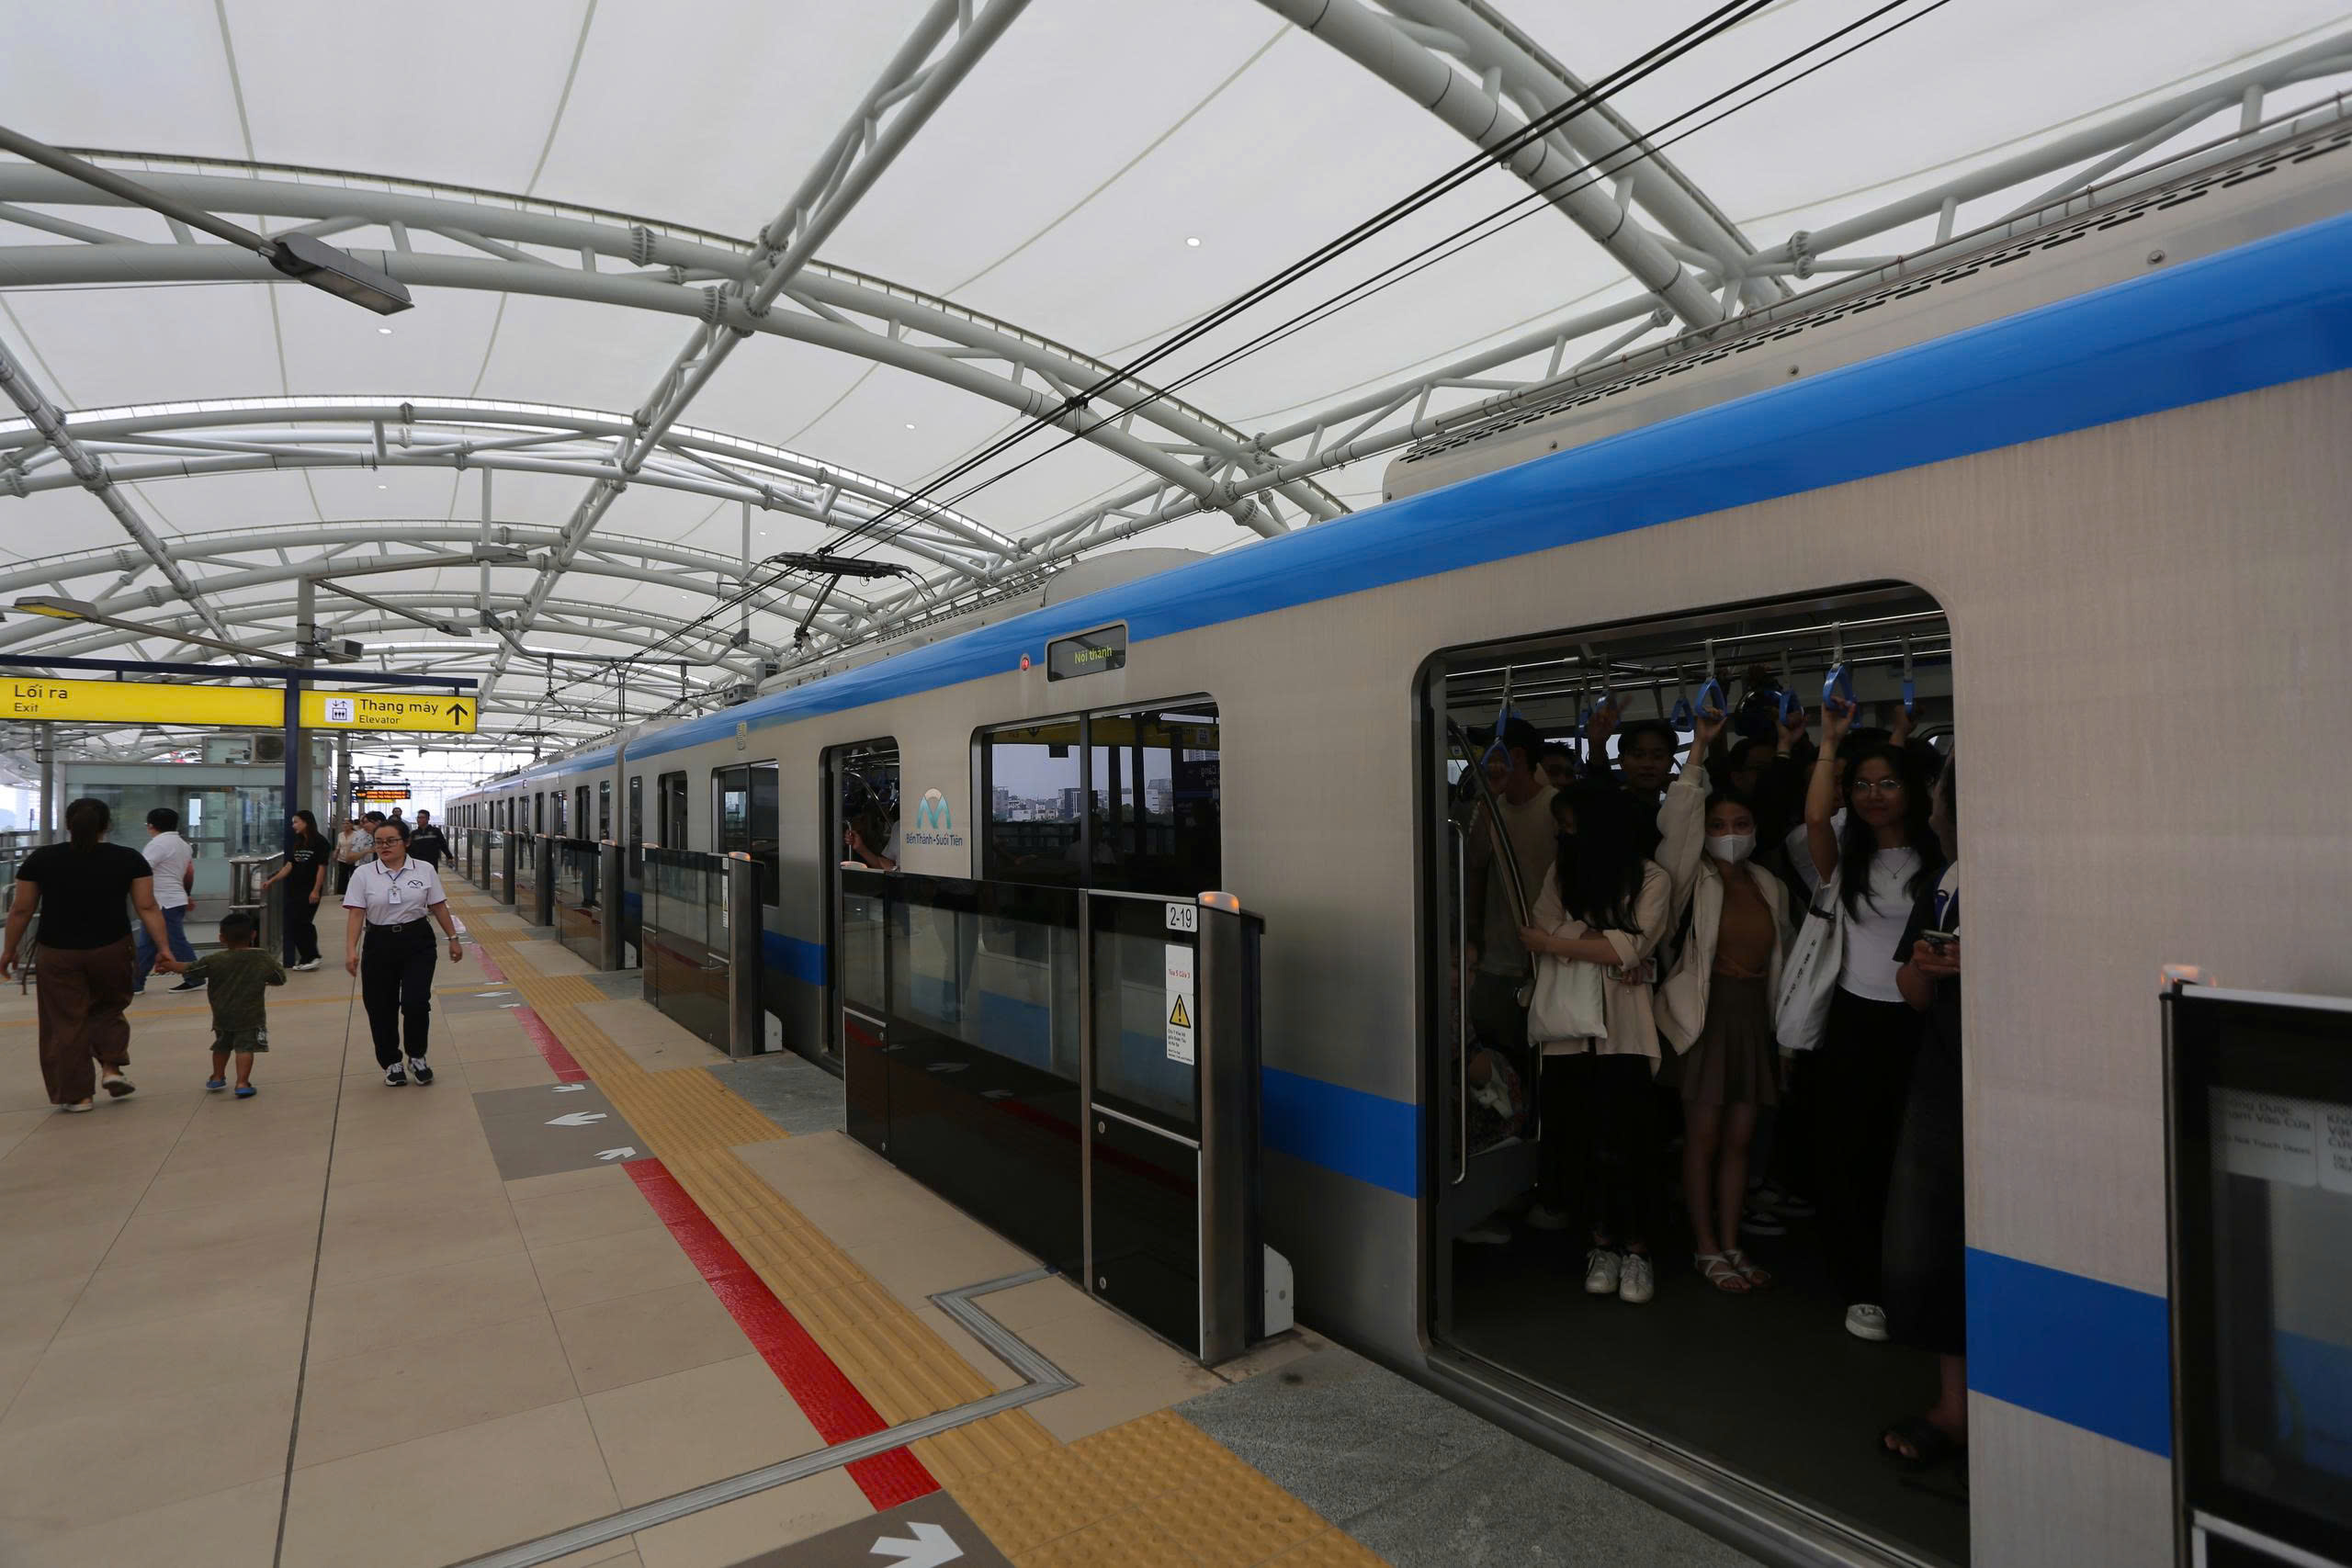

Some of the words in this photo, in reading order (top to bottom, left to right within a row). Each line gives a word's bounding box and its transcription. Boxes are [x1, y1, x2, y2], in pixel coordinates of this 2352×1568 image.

[1074, 649, 1088, 665] Nội
[1089, 645, 1112, 660] thành
[15, 683, 42, 698] Lối
[50, 689, 68, 699] ra
[15, 702, 38, 712] Exit
[359, 698, 404, 715] Thang
[409, 701, 438, 716] máy
[359, 715, 401, 725] Elevator
[1170, 906, 1193, 929] 2-19
